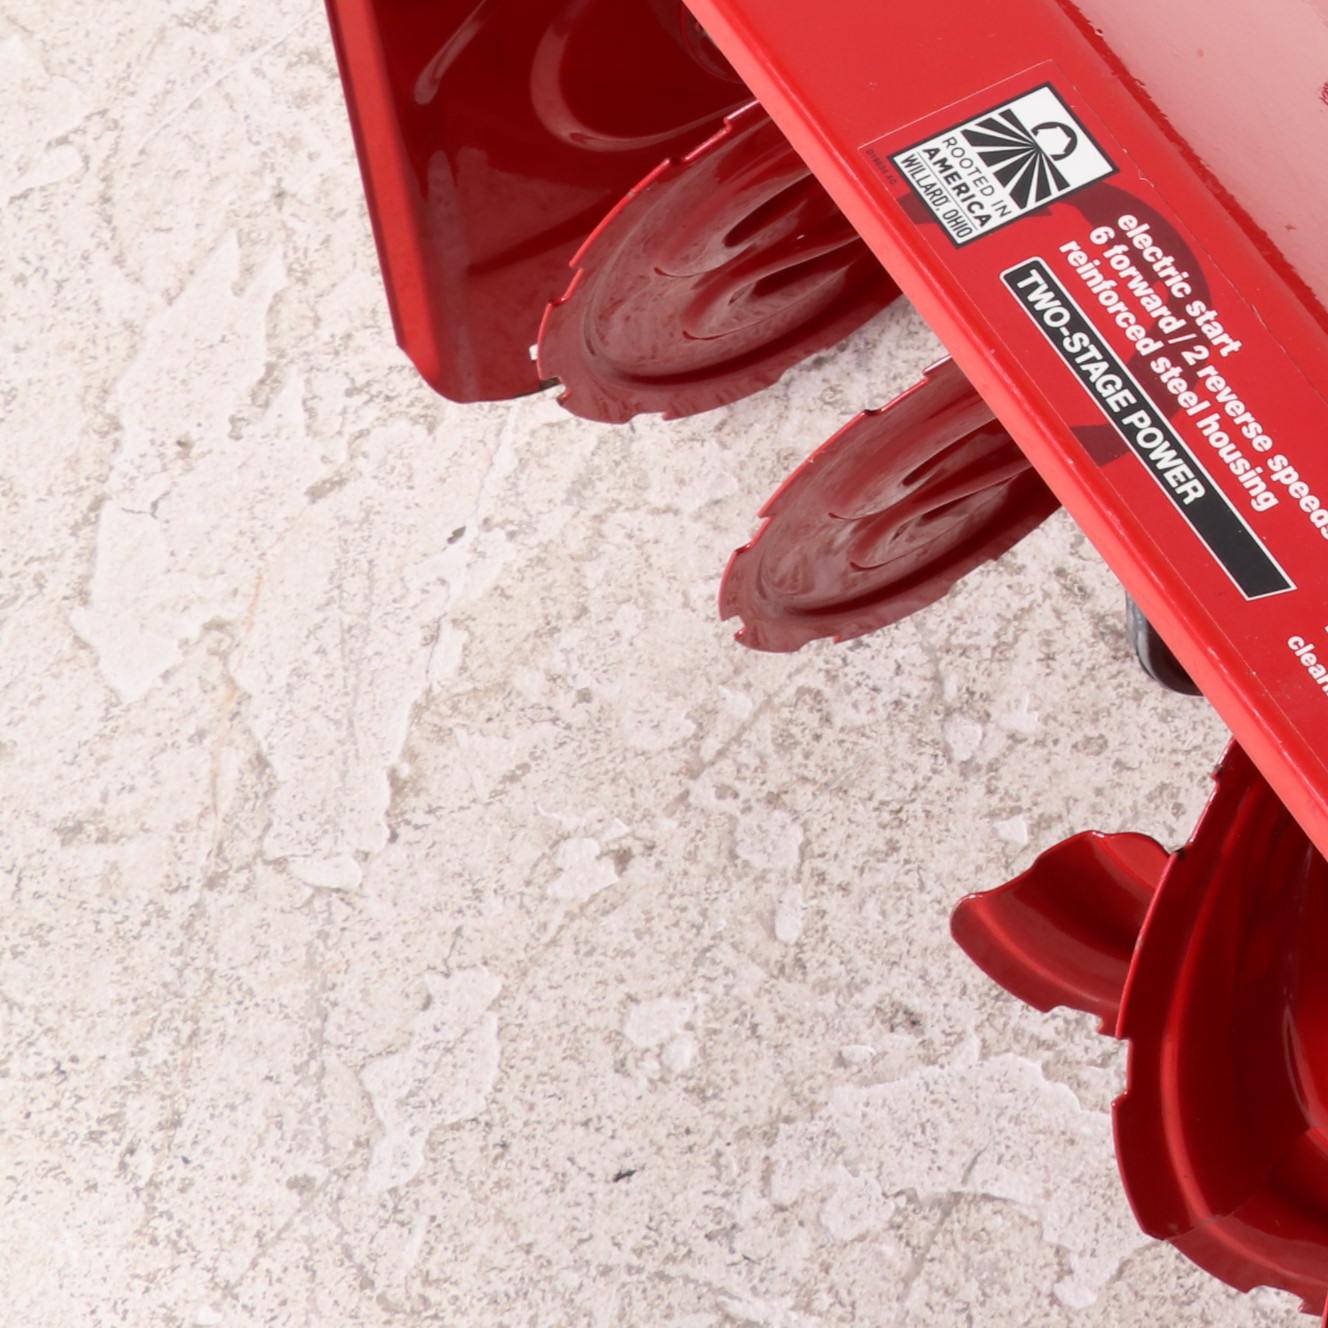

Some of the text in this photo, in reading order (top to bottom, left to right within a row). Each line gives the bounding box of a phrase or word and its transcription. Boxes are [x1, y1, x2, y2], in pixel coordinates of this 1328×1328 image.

[900, 154, 973, 239] WILLARD, OHIO
[922, 147, 993, 228] AMERICA
[942, 136, 1012, 219] ROOTED IN
[1090, 226, 1116, 246] 6
[1104, 244, 1187, 335] forward
[1117, 214, 1244, 358] electric start
[1058, 240, 1279, 513] reinforced steel housing
[1168, 333, 1198, 345] /
[1181, 345, 1210, 366] 2
[1016, 269, 1206, 506] TWO-STAGE POWER
[1196, 364, 1273, 453] reverse
